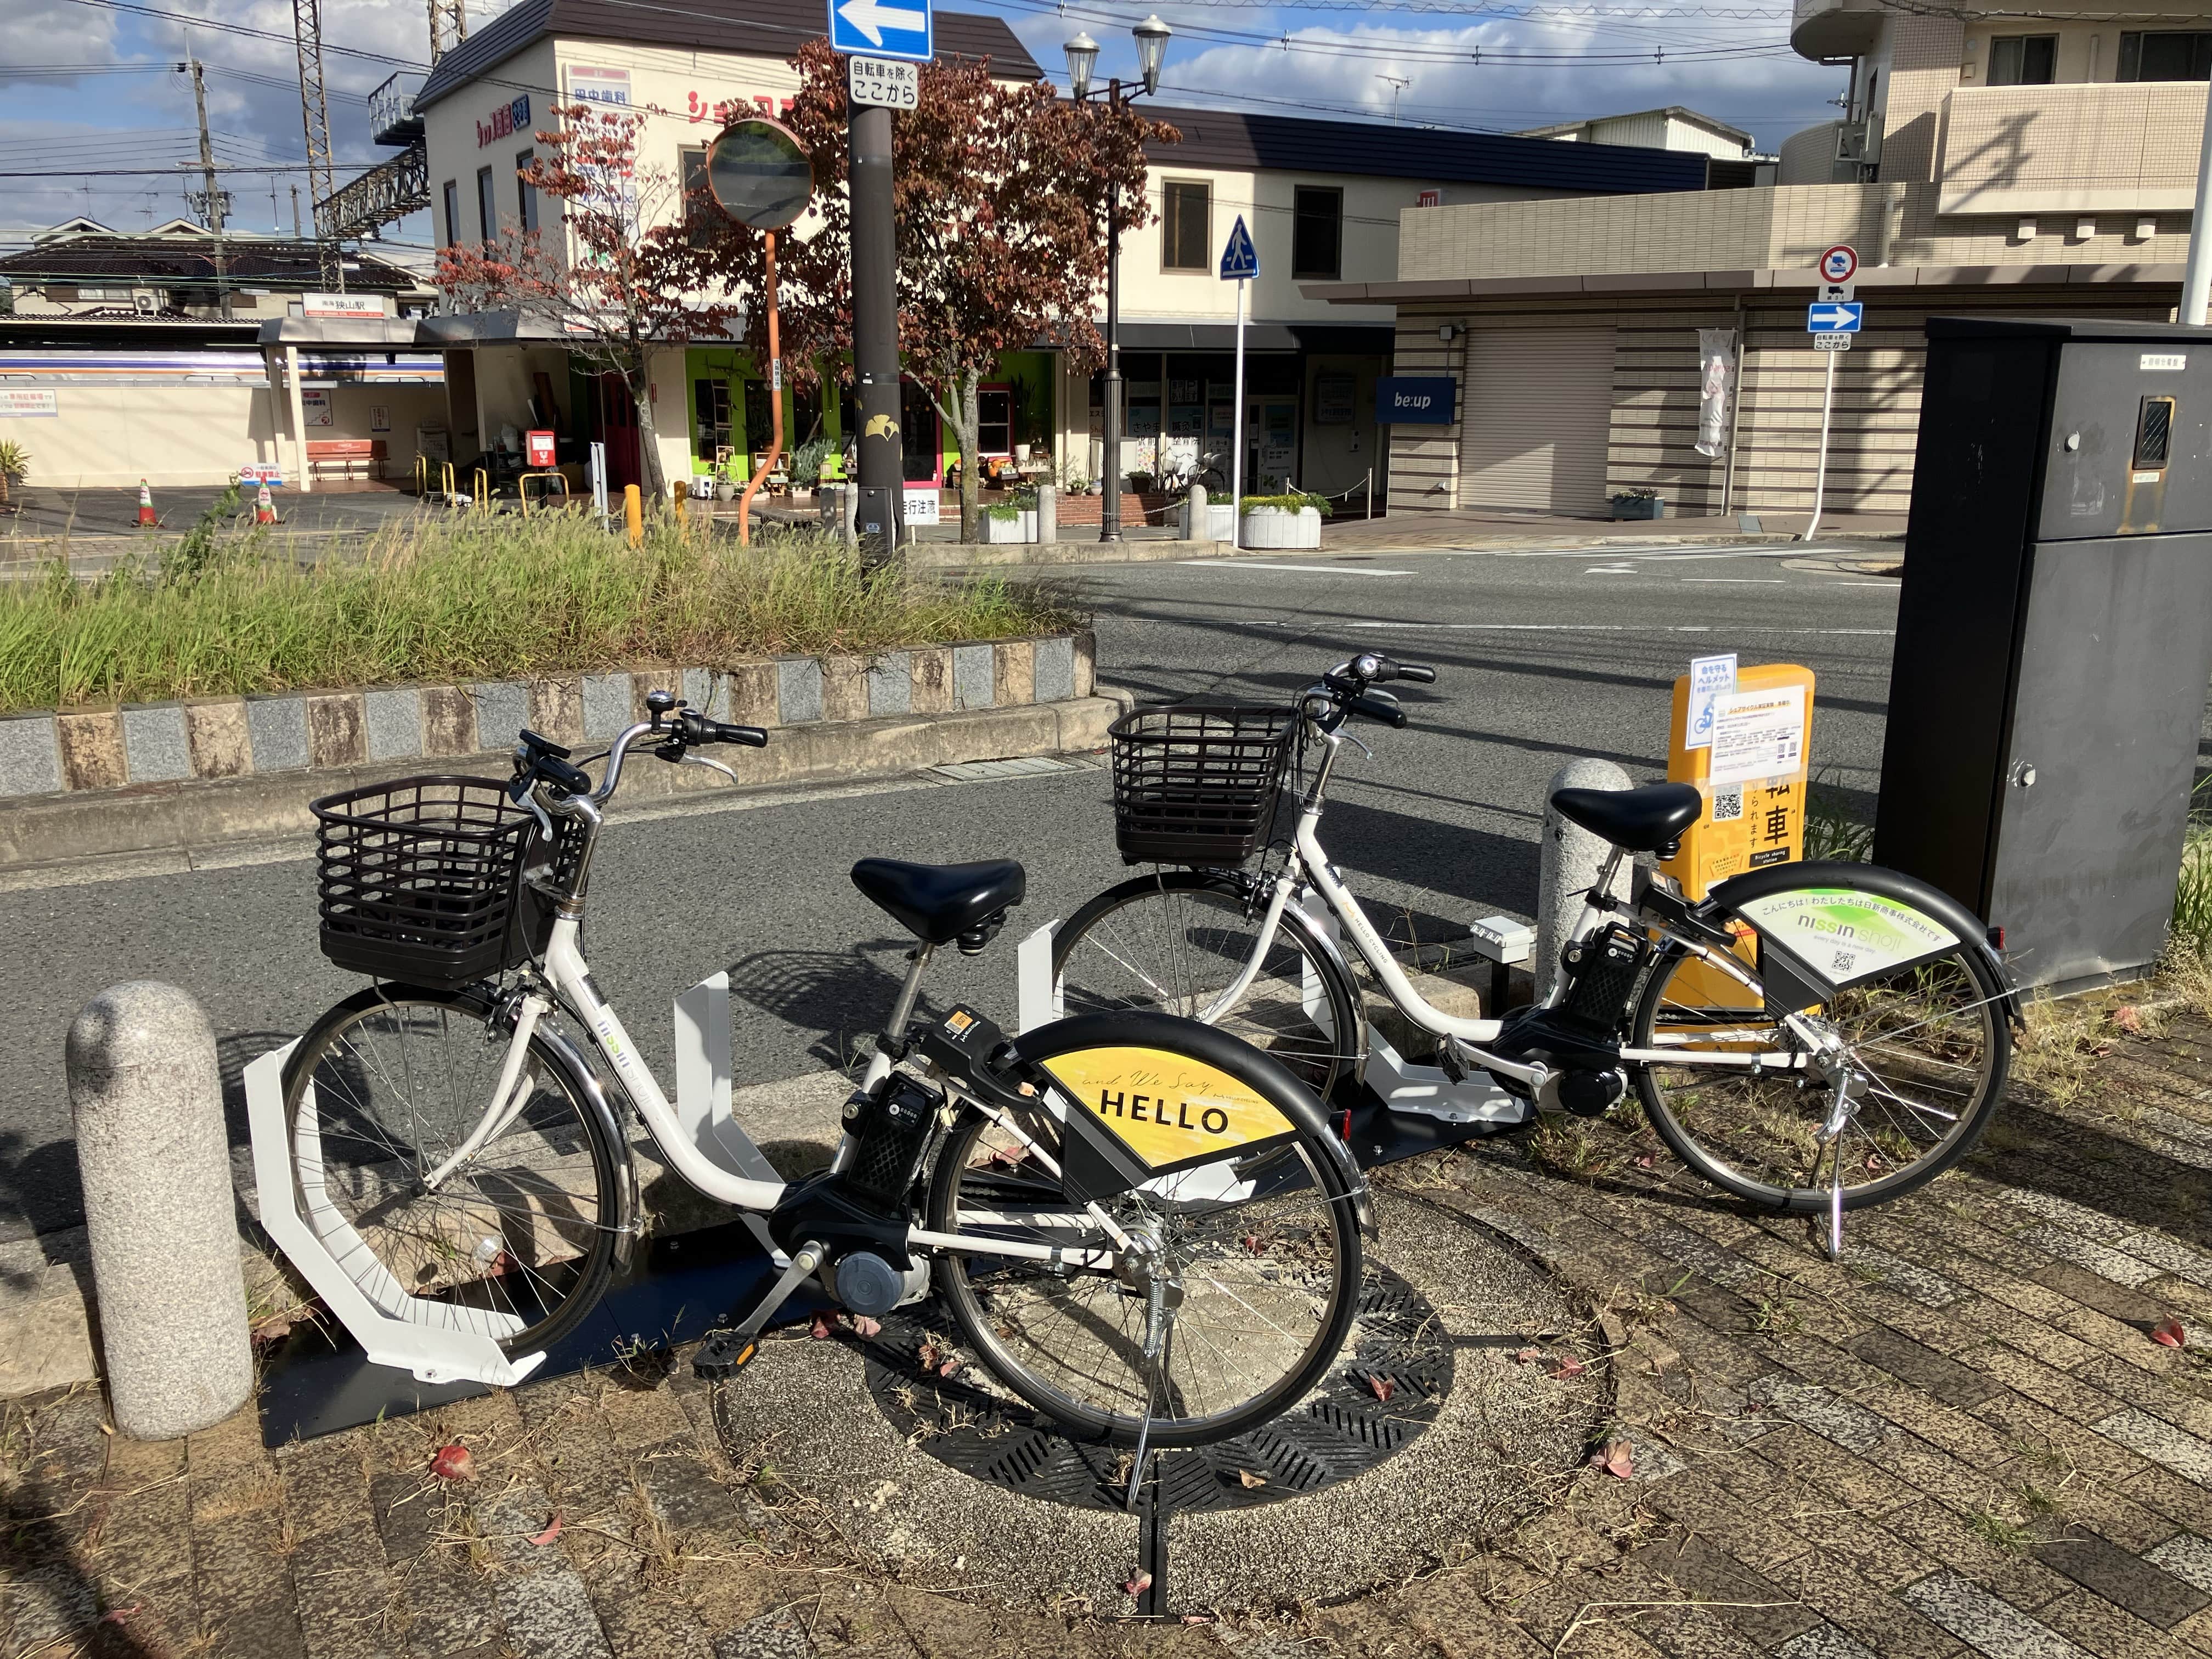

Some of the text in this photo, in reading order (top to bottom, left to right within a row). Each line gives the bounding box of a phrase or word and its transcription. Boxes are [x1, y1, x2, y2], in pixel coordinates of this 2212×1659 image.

[854, 61, 913, 82] 自転車を除く
[575, 88, 626, 105] 田中歯科
[854, 80, 915, 104] ここから
[335, 300, 365, 311] 狭山駅
[1815, 341, 1849, 349] ここから
[1394, 391, 1431, 410] be:up
[1132, 421, 1160, 433] さやま
[1172, 433, 1201, 446] 整骨院
[1698, 673, 1730, 684] ヘルメット
[1355, 918, 1388, 964] HELLO CYCLING
[1797, 914, 1901, 952] nissin shoji
[1814, 935, 1829, 944] every
[1830, 938, 1841, 946] day
[1865, 947, 1876, 955] day
[1082, 1070, 1214, 1095] and We Say
[1100, 1088, 1229, 1135] HELLO
